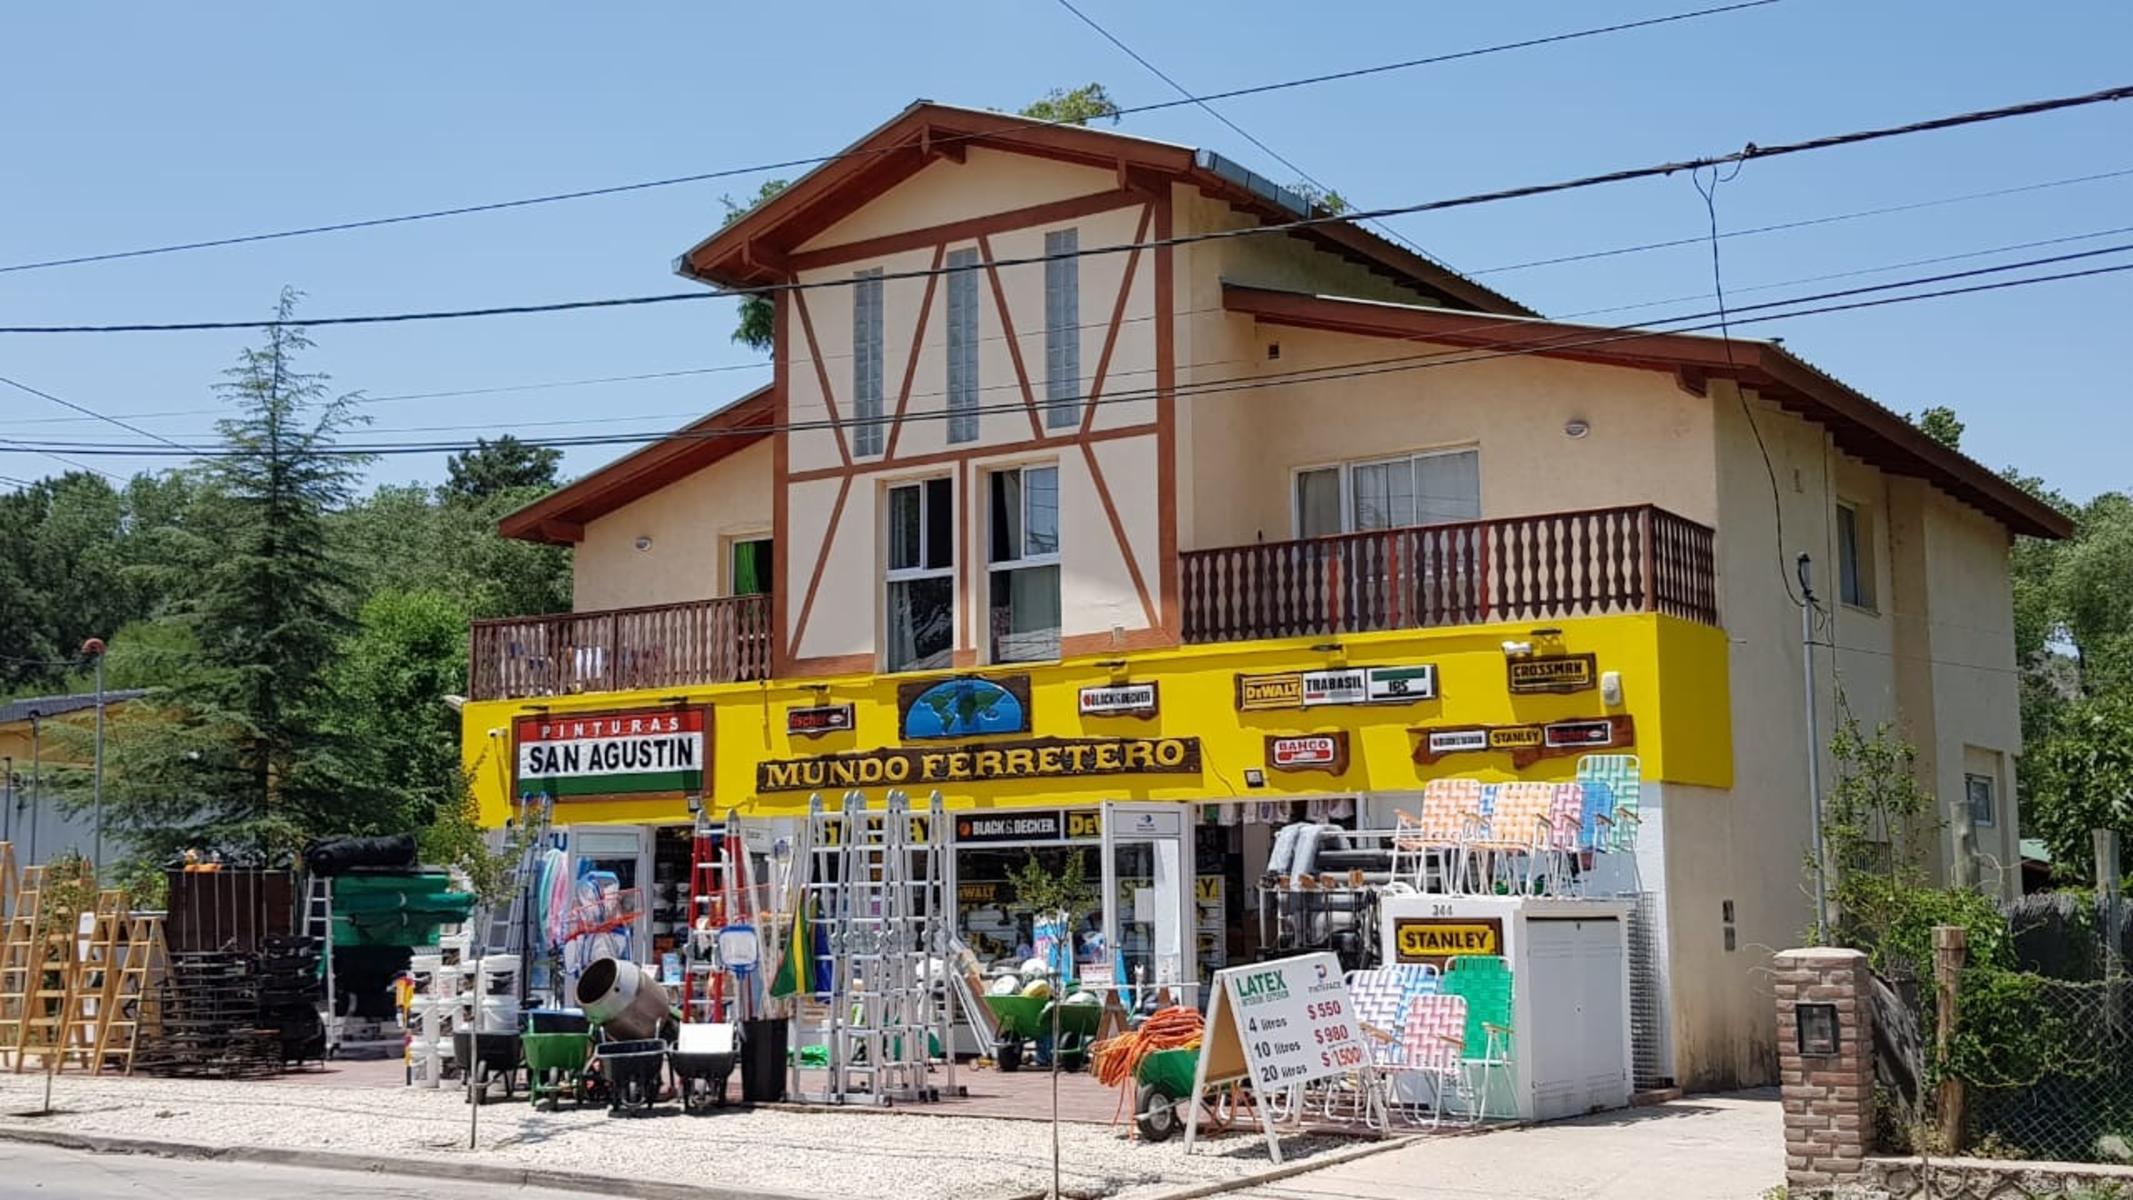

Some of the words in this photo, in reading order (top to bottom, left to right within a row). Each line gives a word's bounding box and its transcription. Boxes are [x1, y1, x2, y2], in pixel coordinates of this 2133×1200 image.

[1513, 662, 1583, 677] CROSSMAN
[1305, 675, 1363, 692] TRABASIL
[1388, 680, 1409, 694] IPS
[541, 716, 680, 739] PINTURAS
[1494, 729, 1540, 744] STANLEY
[1278, 739, 1329, 751] BAHCO
[528, 744, 581, 774] SAN
[588, 737, 693, 771] AGUSTIN
[766, 756, 909, 787] MUNDO
[921, 740, 1185, 779] FERRETERO
[1405, 931, 1489, 949] STANLEY
[1235, 970, 1288, 998] LATEX
[1249, 1016, 1258, 1033] 4
[1261, 1017, 1288, 1032] litros
[1254, 1041, 1271, 1059] 10
[1274, 1041, 1301, 1055] litros
[1261, 1064, 1279, 1083] 20
[1281, 1064, 1308, 1078] litros
